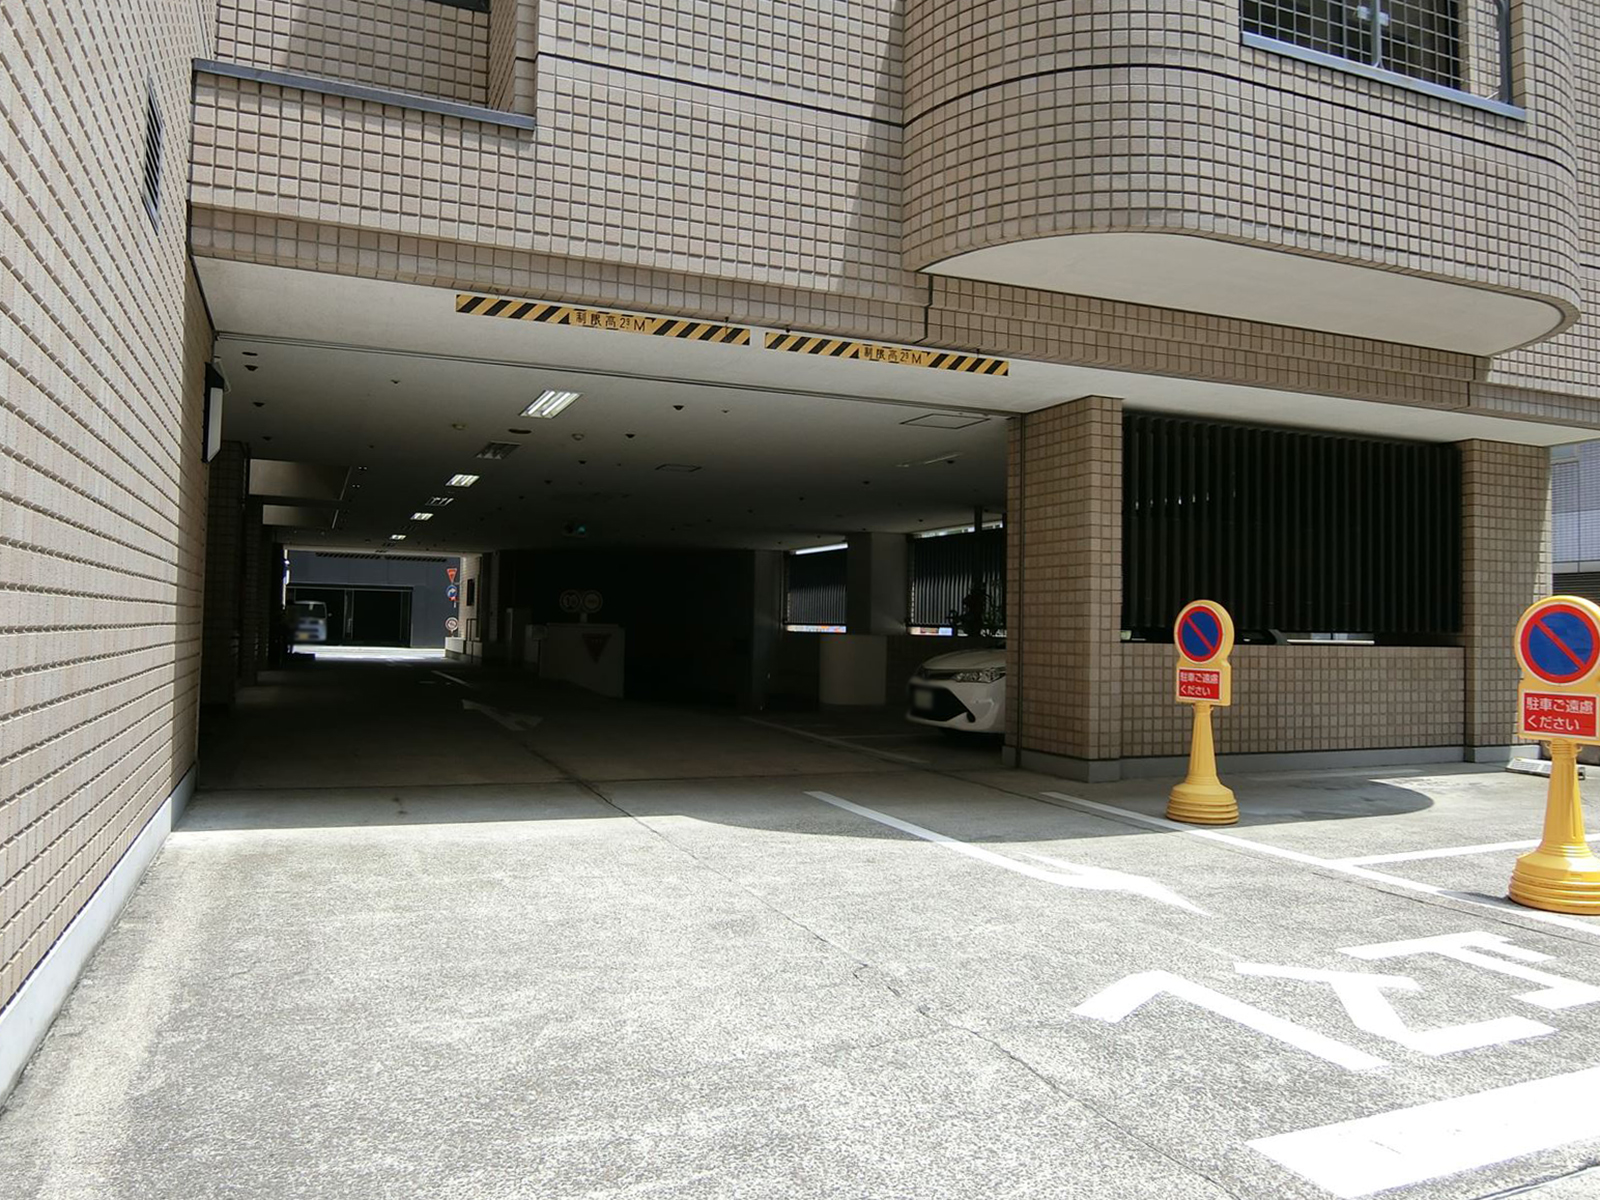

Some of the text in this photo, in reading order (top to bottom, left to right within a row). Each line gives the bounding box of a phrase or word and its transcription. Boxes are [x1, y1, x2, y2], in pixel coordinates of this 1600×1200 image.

[1180, 685, 1211, 697] ください
[1526, 696, 1594, 715] 駐車ご遠慮
[1527, 714, 1580, 731] ください
